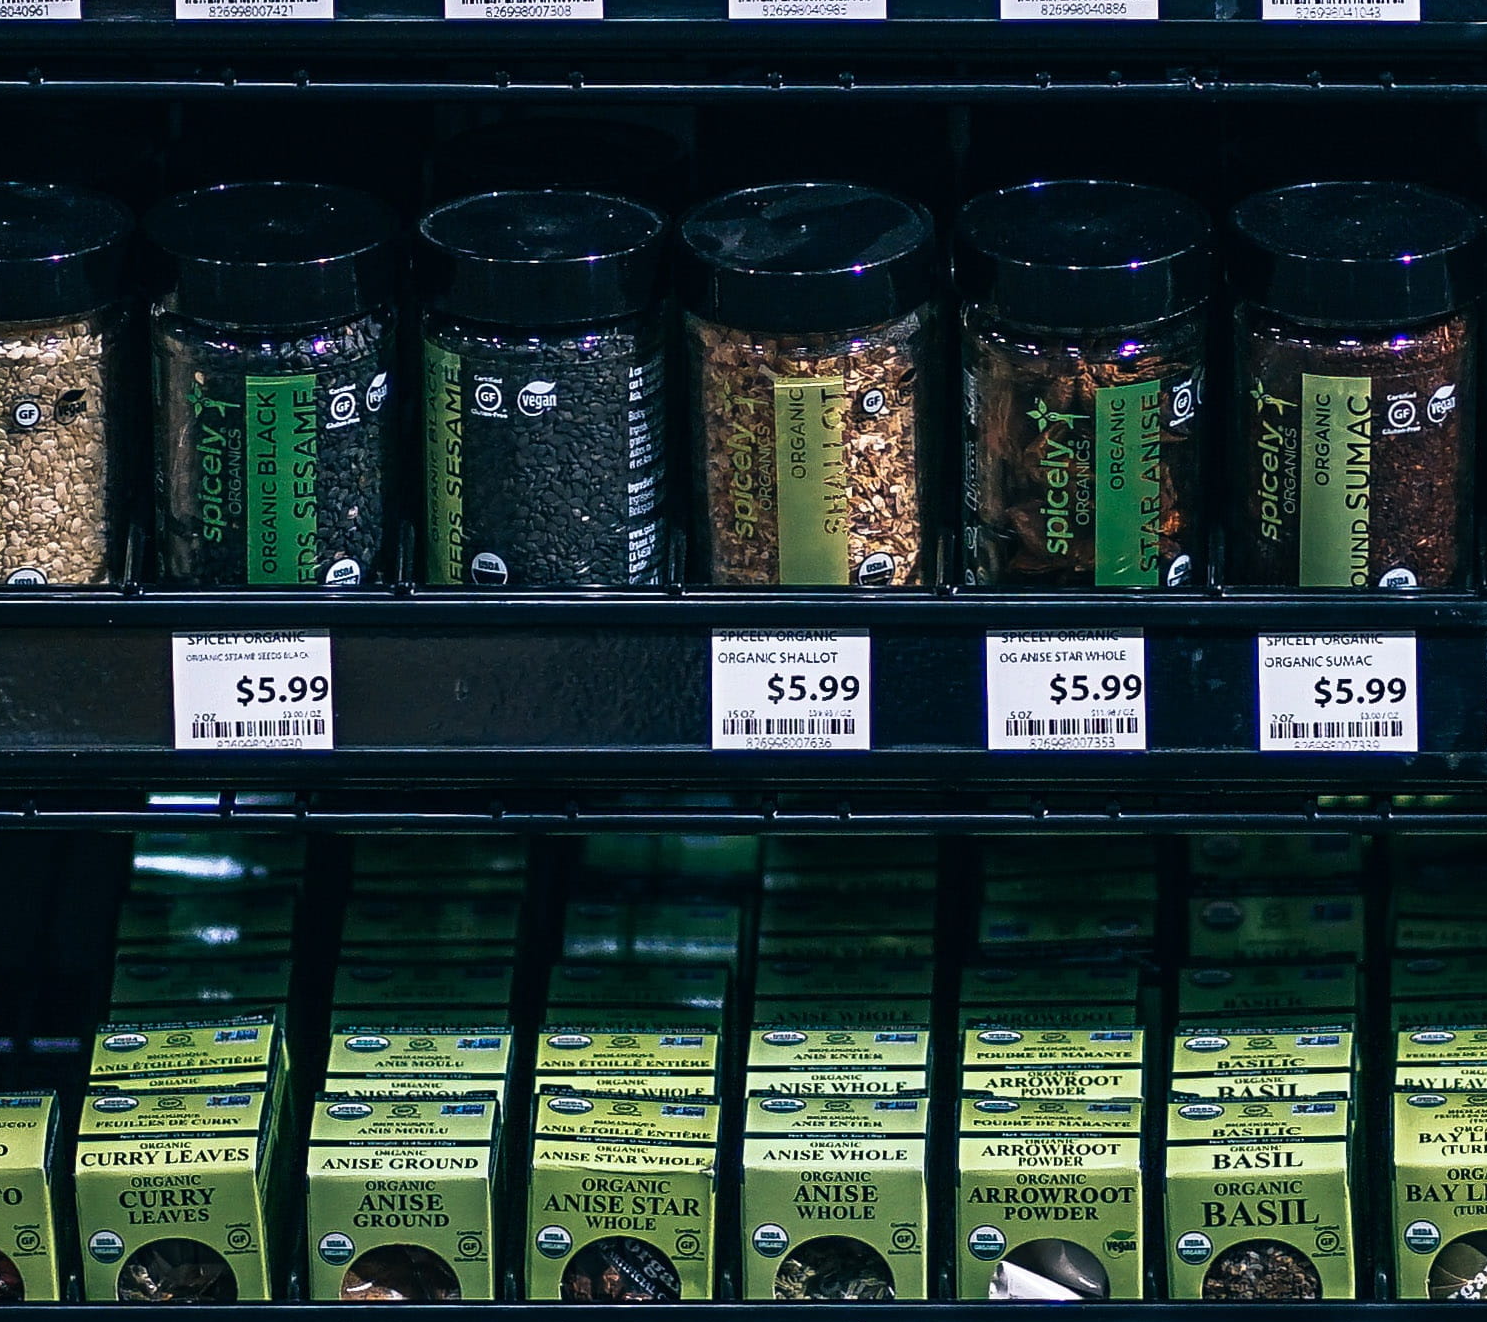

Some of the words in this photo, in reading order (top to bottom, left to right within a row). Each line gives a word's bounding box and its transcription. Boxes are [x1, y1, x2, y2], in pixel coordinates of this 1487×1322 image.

[1050, 674, 1141, 704] $5.99
[543, 1194, 624, 1220] ANISE
[632, 1196, 701, 1216] STAR
[1201, 1199, 1324, 1231] BASIL
